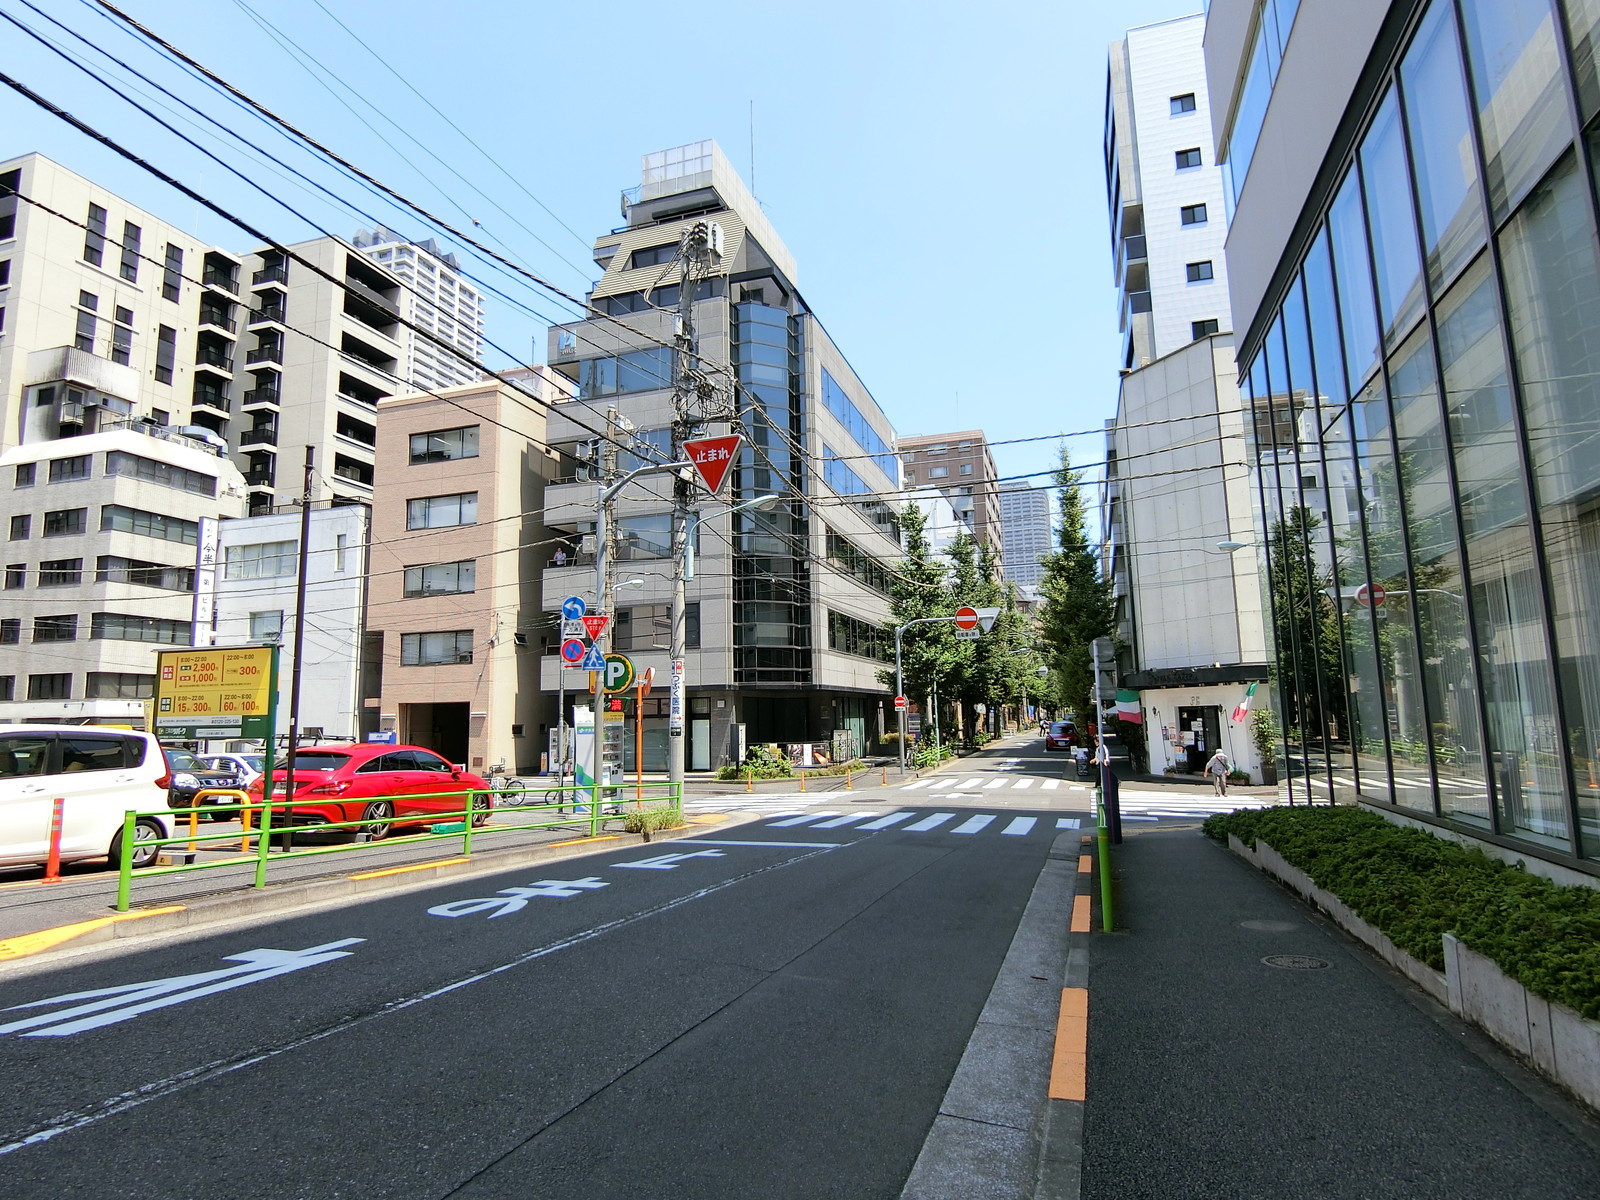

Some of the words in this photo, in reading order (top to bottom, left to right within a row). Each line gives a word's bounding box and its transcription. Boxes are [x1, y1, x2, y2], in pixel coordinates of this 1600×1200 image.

[696, 447, 730, 463] 止まれ
[607, 662, 625, 687] P
